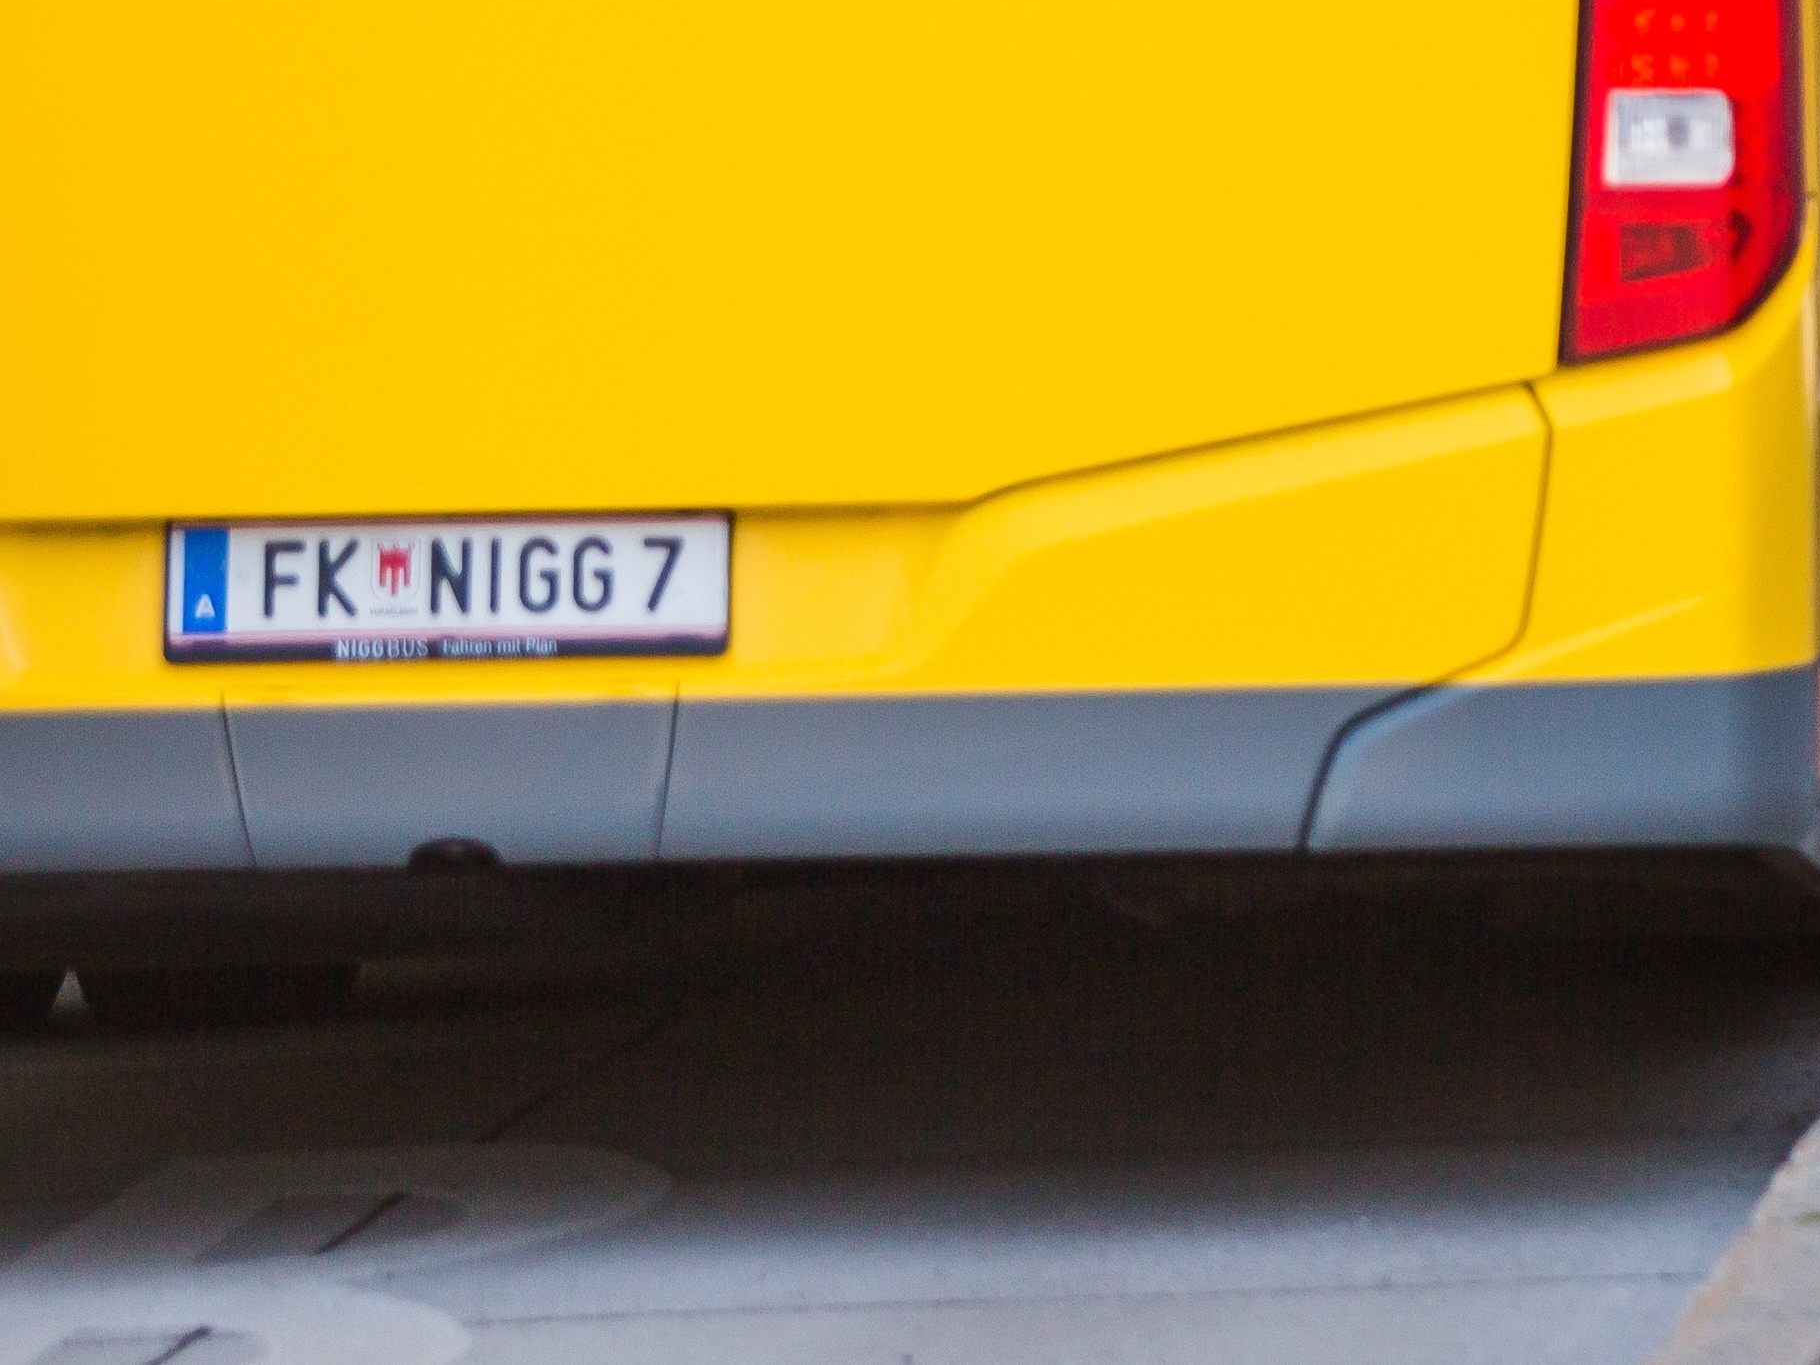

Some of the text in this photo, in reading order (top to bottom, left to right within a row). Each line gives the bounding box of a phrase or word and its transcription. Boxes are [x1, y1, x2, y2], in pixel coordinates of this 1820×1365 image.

[263, 536, 684, 618] FK NIGG 7
[194, 594, 216, 619] A
[497, 636, 521, 654] mit
[525, 635, 558, 653] Plan
